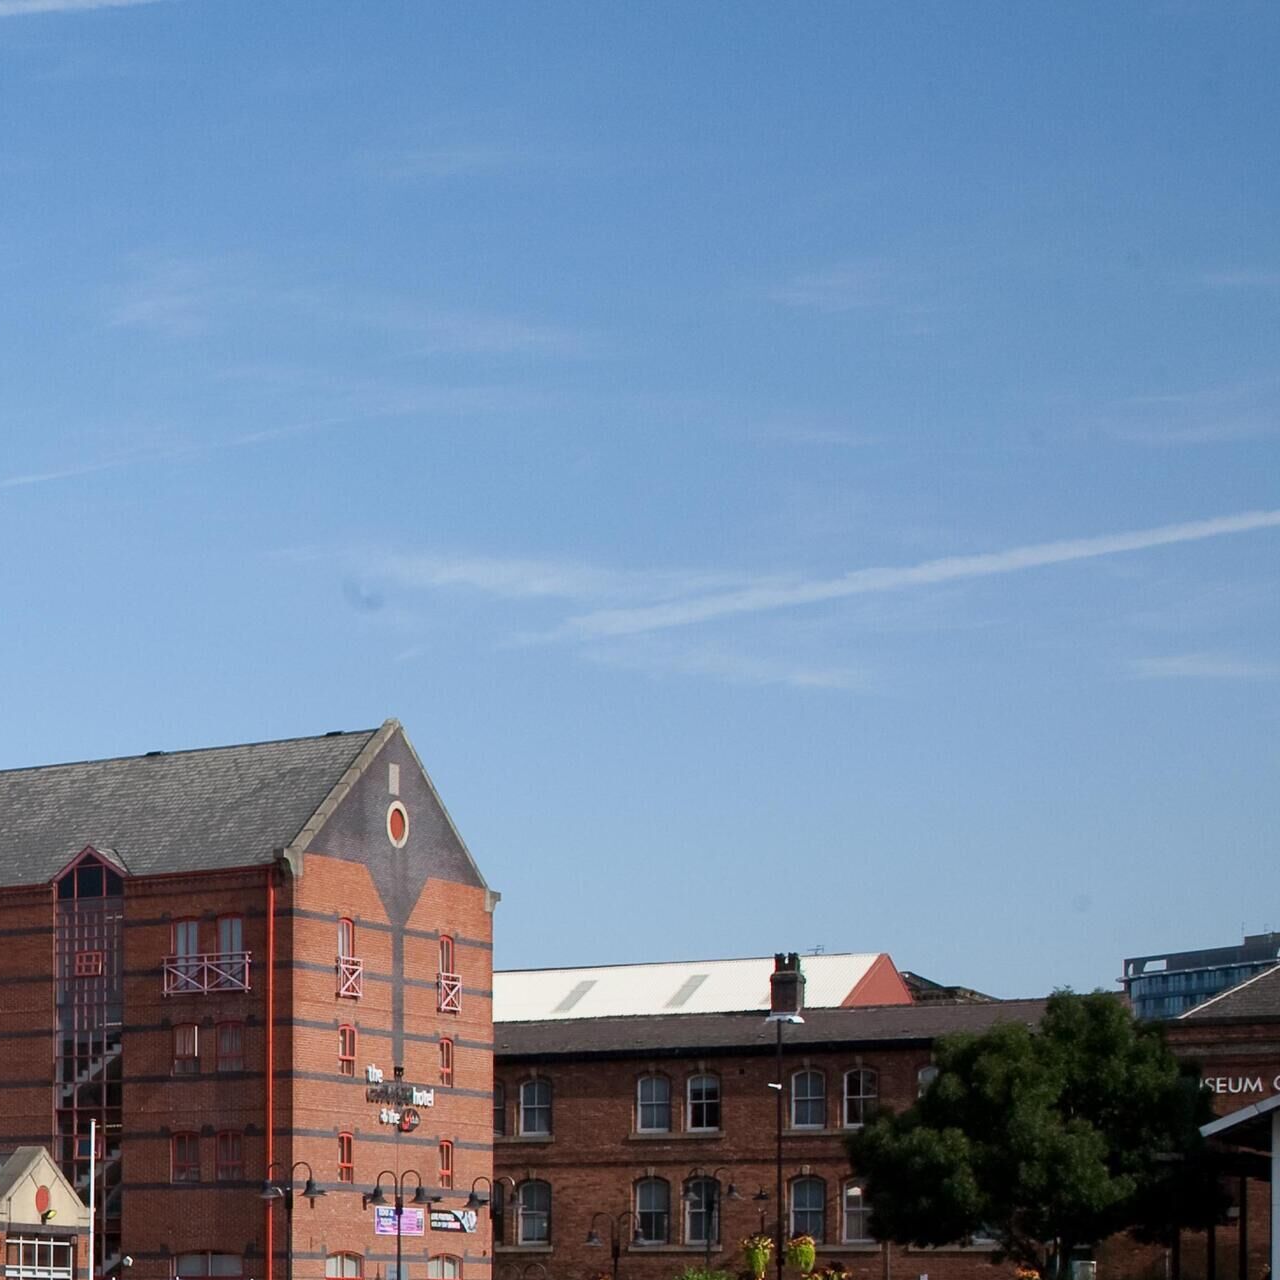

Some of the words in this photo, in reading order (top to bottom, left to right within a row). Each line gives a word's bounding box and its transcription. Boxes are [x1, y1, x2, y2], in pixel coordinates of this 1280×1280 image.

[366, 1063, 383, 1083] the
[1200, 1077, 1263, 1093] SEUM
[412, 1087, 434, 1107] hotel
